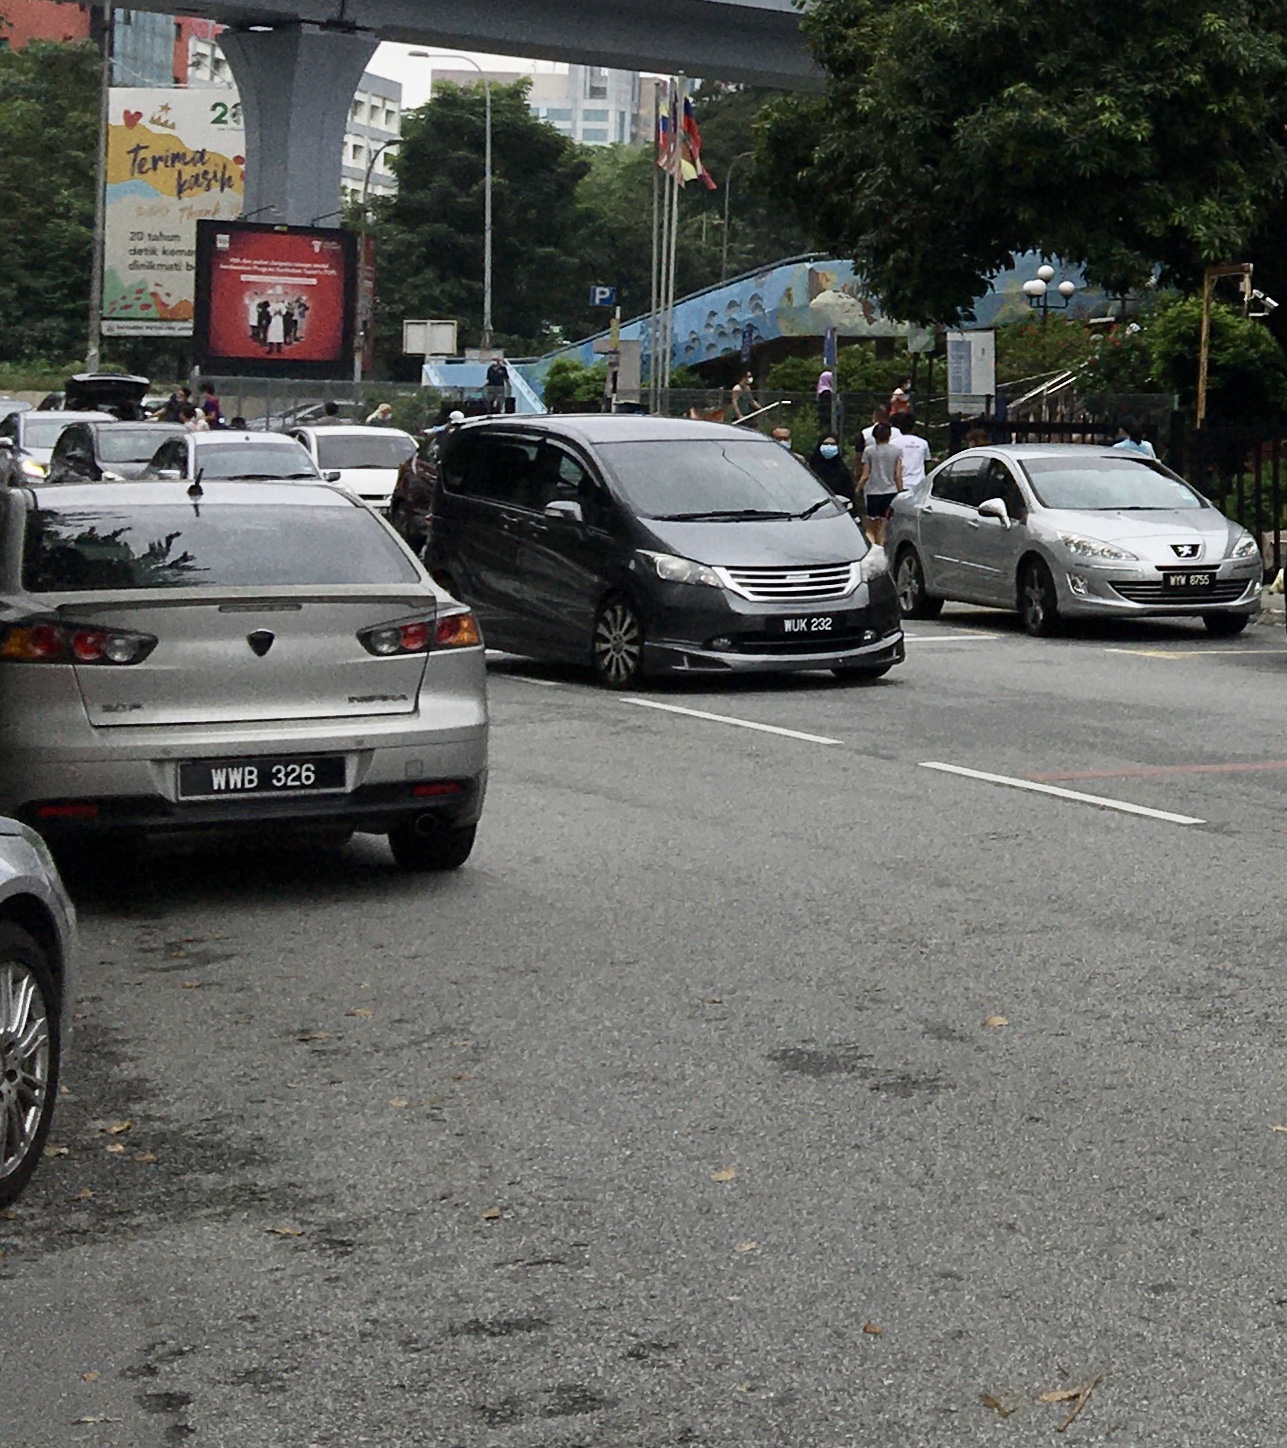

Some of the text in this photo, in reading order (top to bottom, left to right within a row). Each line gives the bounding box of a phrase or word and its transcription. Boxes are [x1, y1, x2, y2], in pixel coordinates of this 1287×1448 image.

[127, 143, 209, 176] Terima
[175, 163, 234, 200] kasih
[595, 288, 611, 304] P
[784, 617, 832, 632] WUK 232
[211, 763, 316, 791] WWB 326
